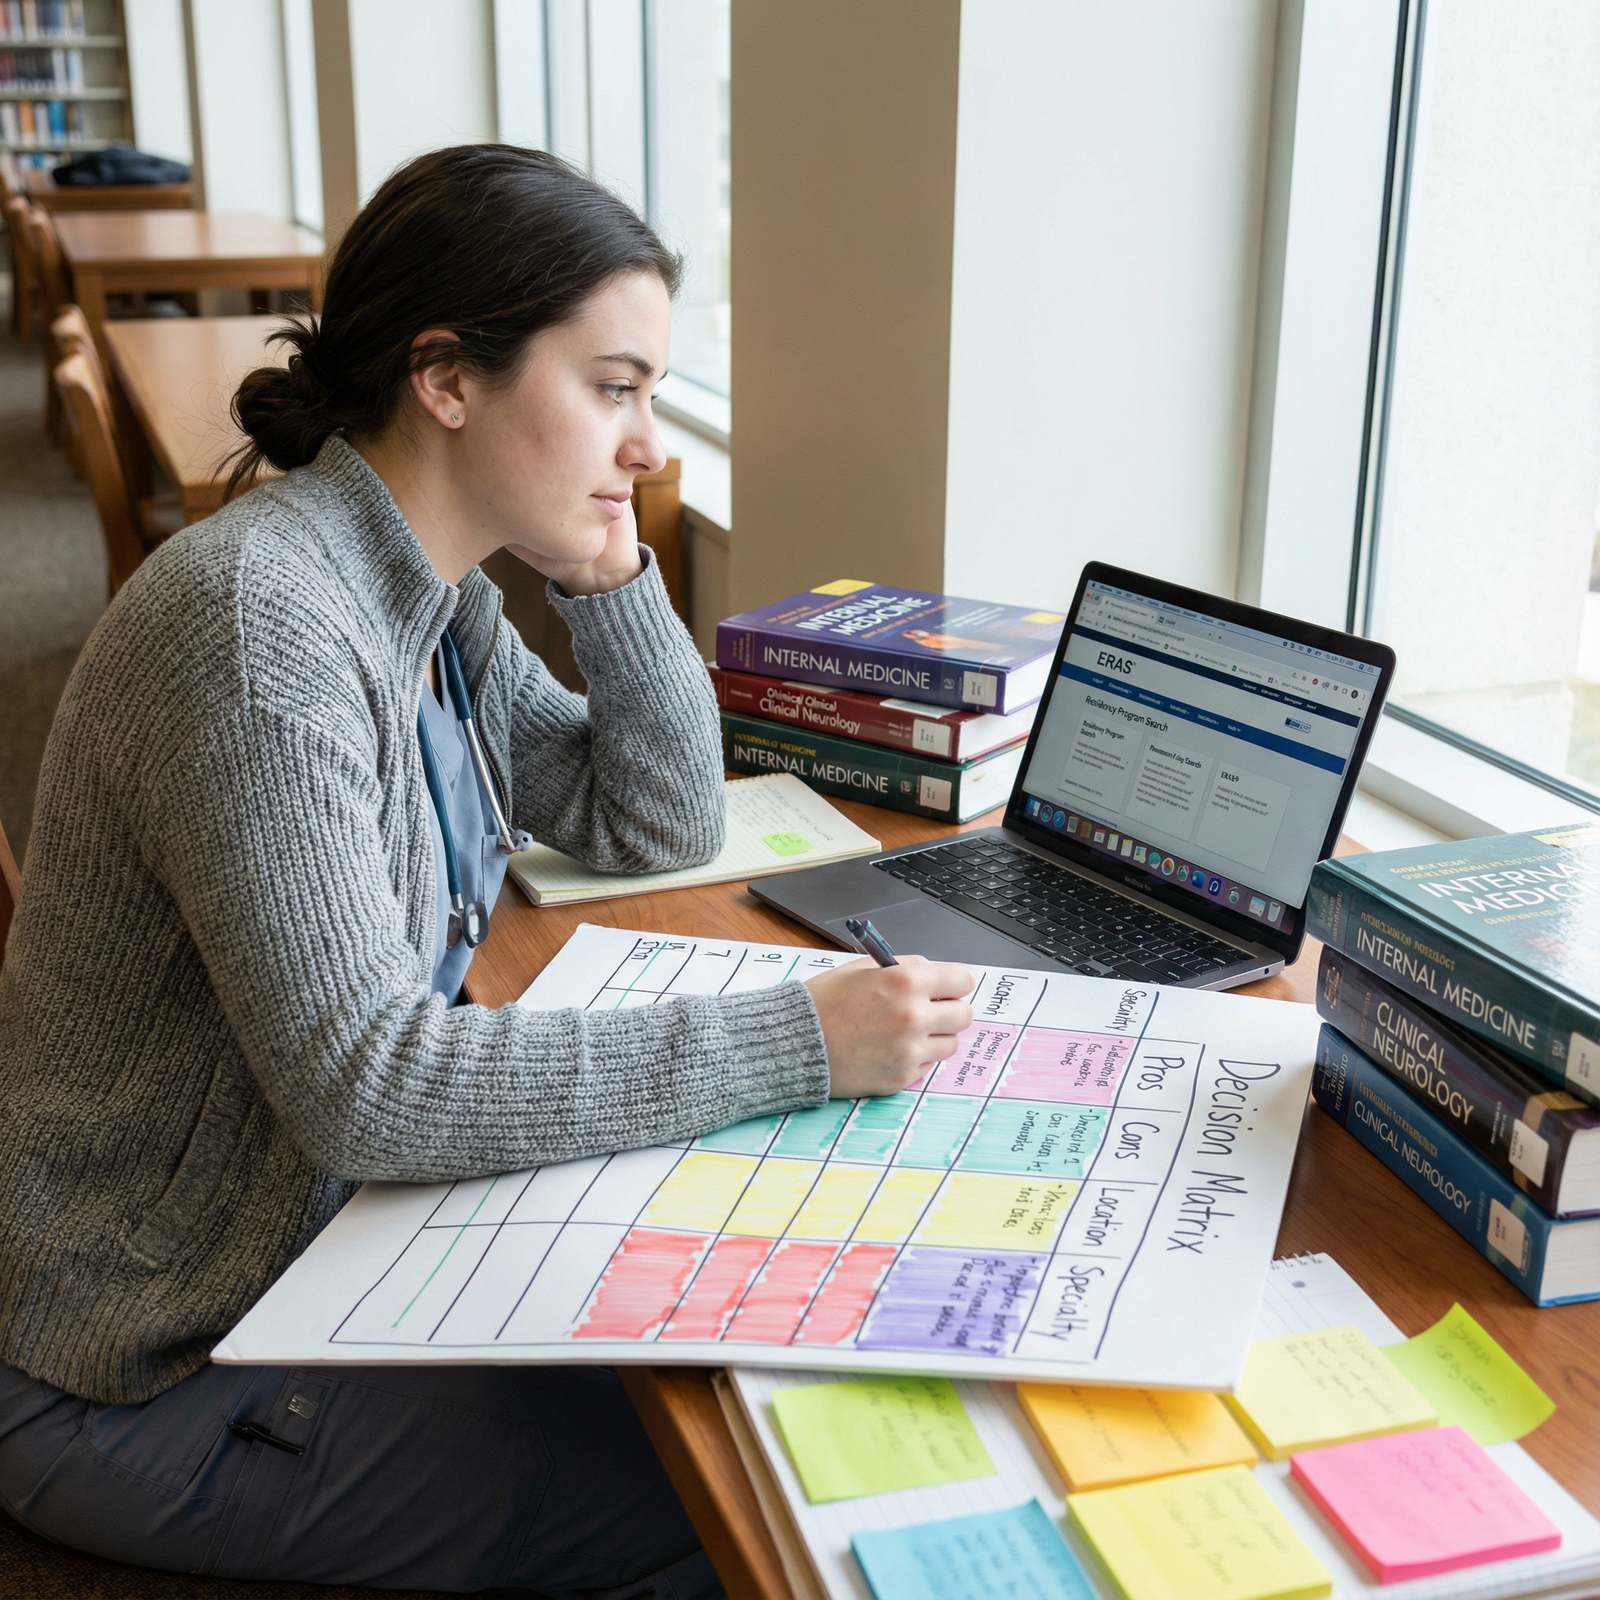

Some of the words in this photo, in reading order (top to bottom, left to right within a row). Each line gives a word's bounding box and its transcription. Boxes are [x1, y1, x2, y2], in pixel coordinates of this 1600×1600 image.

[764, 646, 842, 675] INTERNAL
[847, 660, 930, 690] MEDICINE
[760, 697, 799, 719] Clinical
[802, 705, 860, 735] Neurology
[734, 744, 807, 775] INTERNAL
[811, 763, 889, 794] MEDICINE
[1357, 927, 1437, 994] INTERNAL
[1443, 978, 1536, 1050] MEDICINE
[1137, 1055, 1185, 1091] Pros
[1377, 1001, 1446, 1075] CLINICAL
[1196, 1058, 1281, 1155] Decision
[1373, 1027, 1474, 1125] NEUROLOGY
[1115, 1121, 1160, 1160] Cons
[1354, 1100, 1399, 1153] CLINICAL
[1401, 1144, 1472, 1214] NEUROLOGY
[1082, 1187, 1135, 1246] Location
[1166, 1170, 1248, 1254] Matrix
[1028, 1265, 1105, 1341] Specialty
